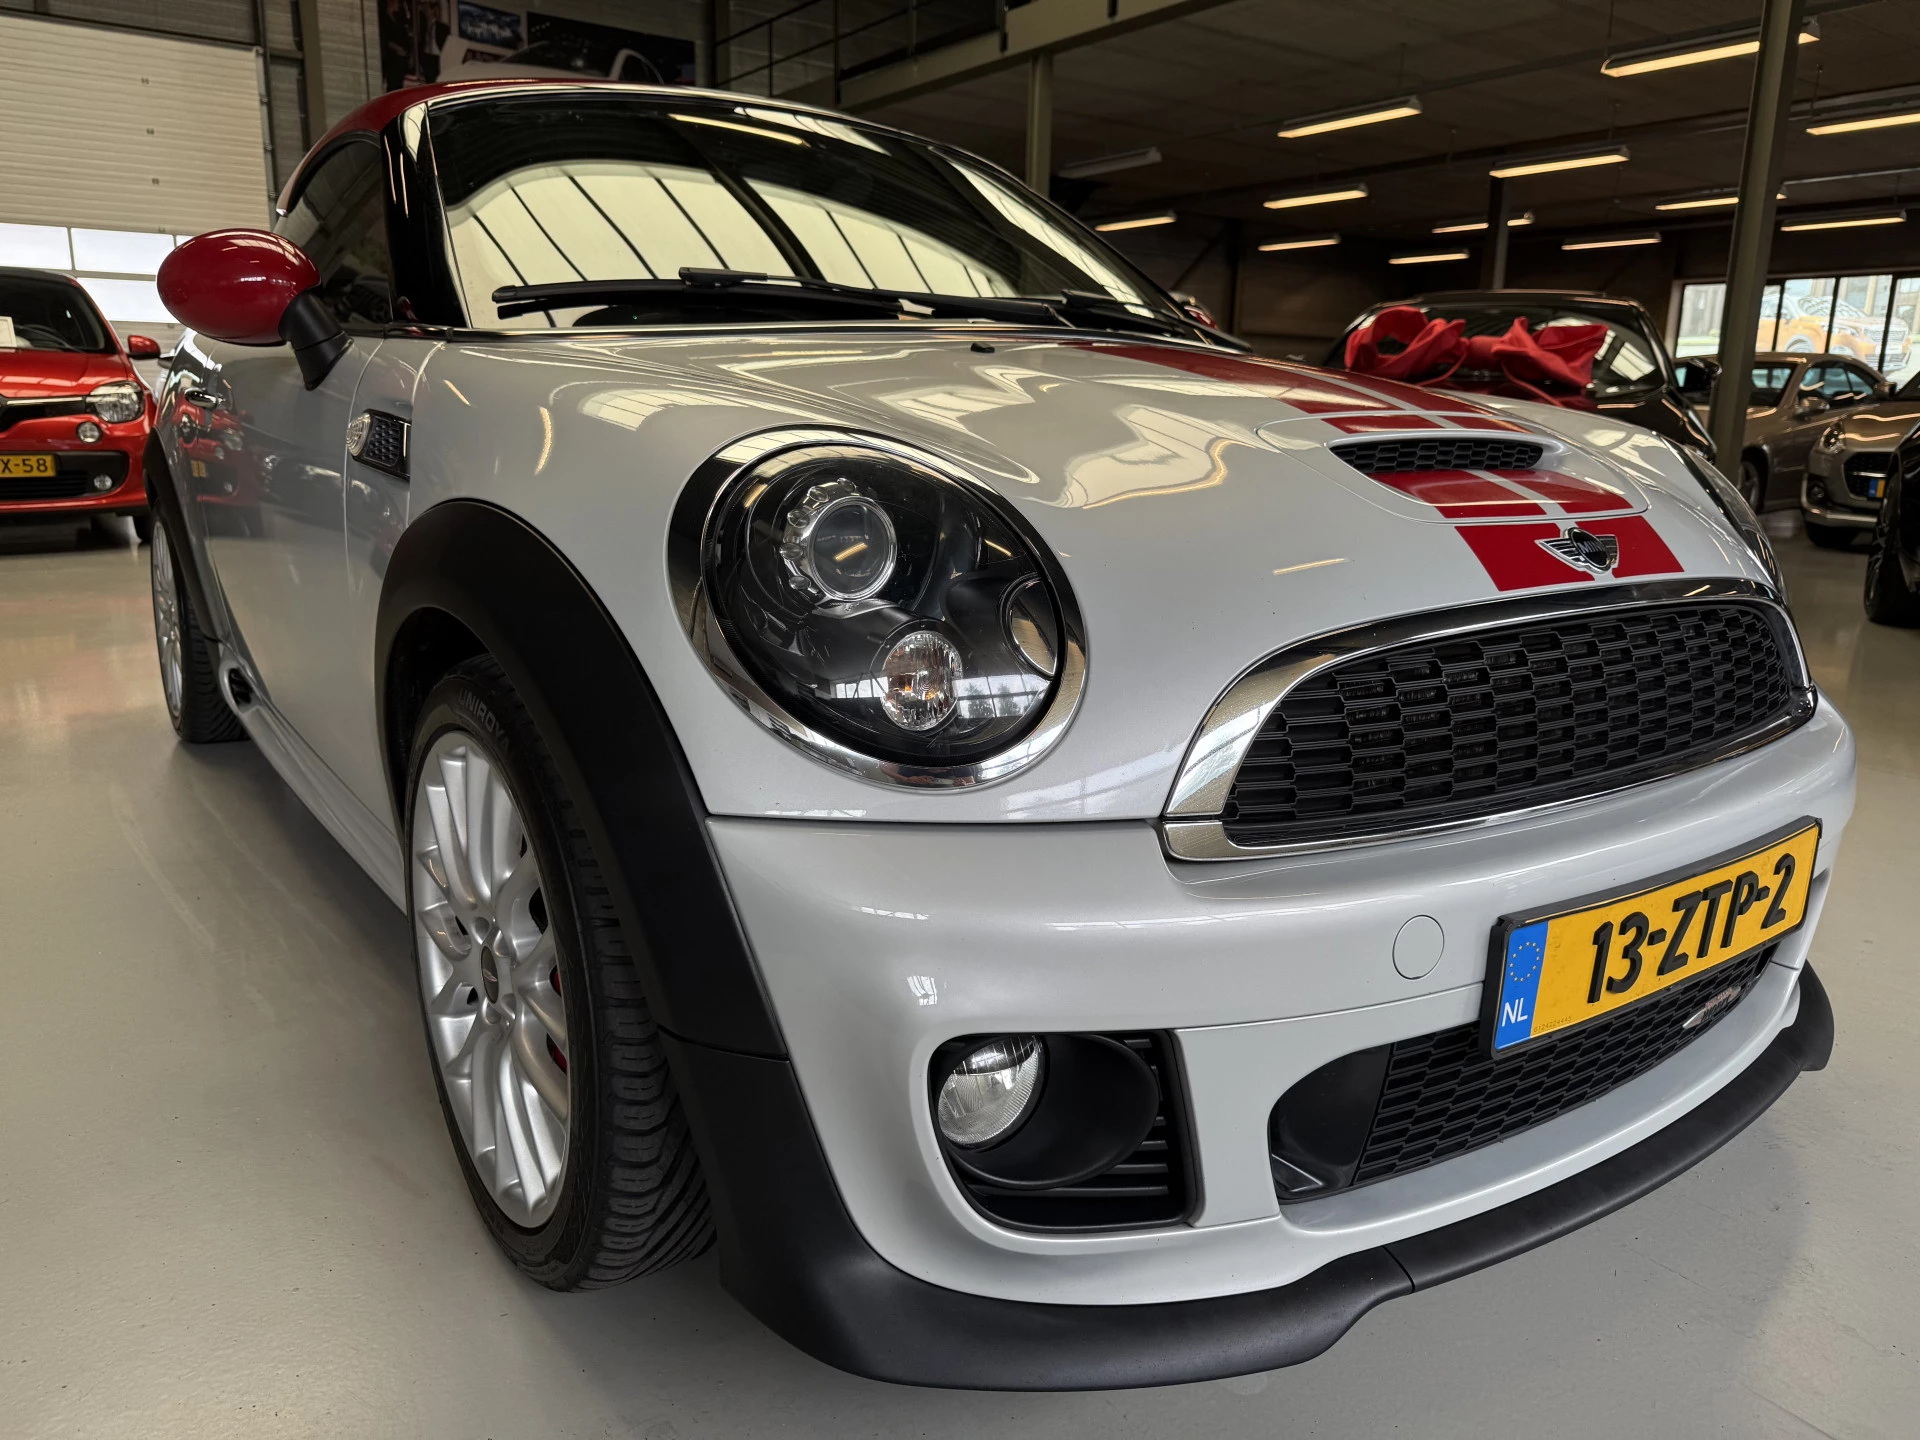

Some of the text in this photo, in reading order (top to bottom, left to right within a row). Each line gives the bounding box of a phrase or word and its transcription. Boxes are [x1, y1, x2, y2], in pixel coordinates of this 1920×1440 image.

[0, 458, 48, 474] X-58
[458, 687, 510, 754] UNIROYA
[1587, 853, 1796, 1004] 13-ZTP-2
[1502, 997, 1528, 1027] NL
